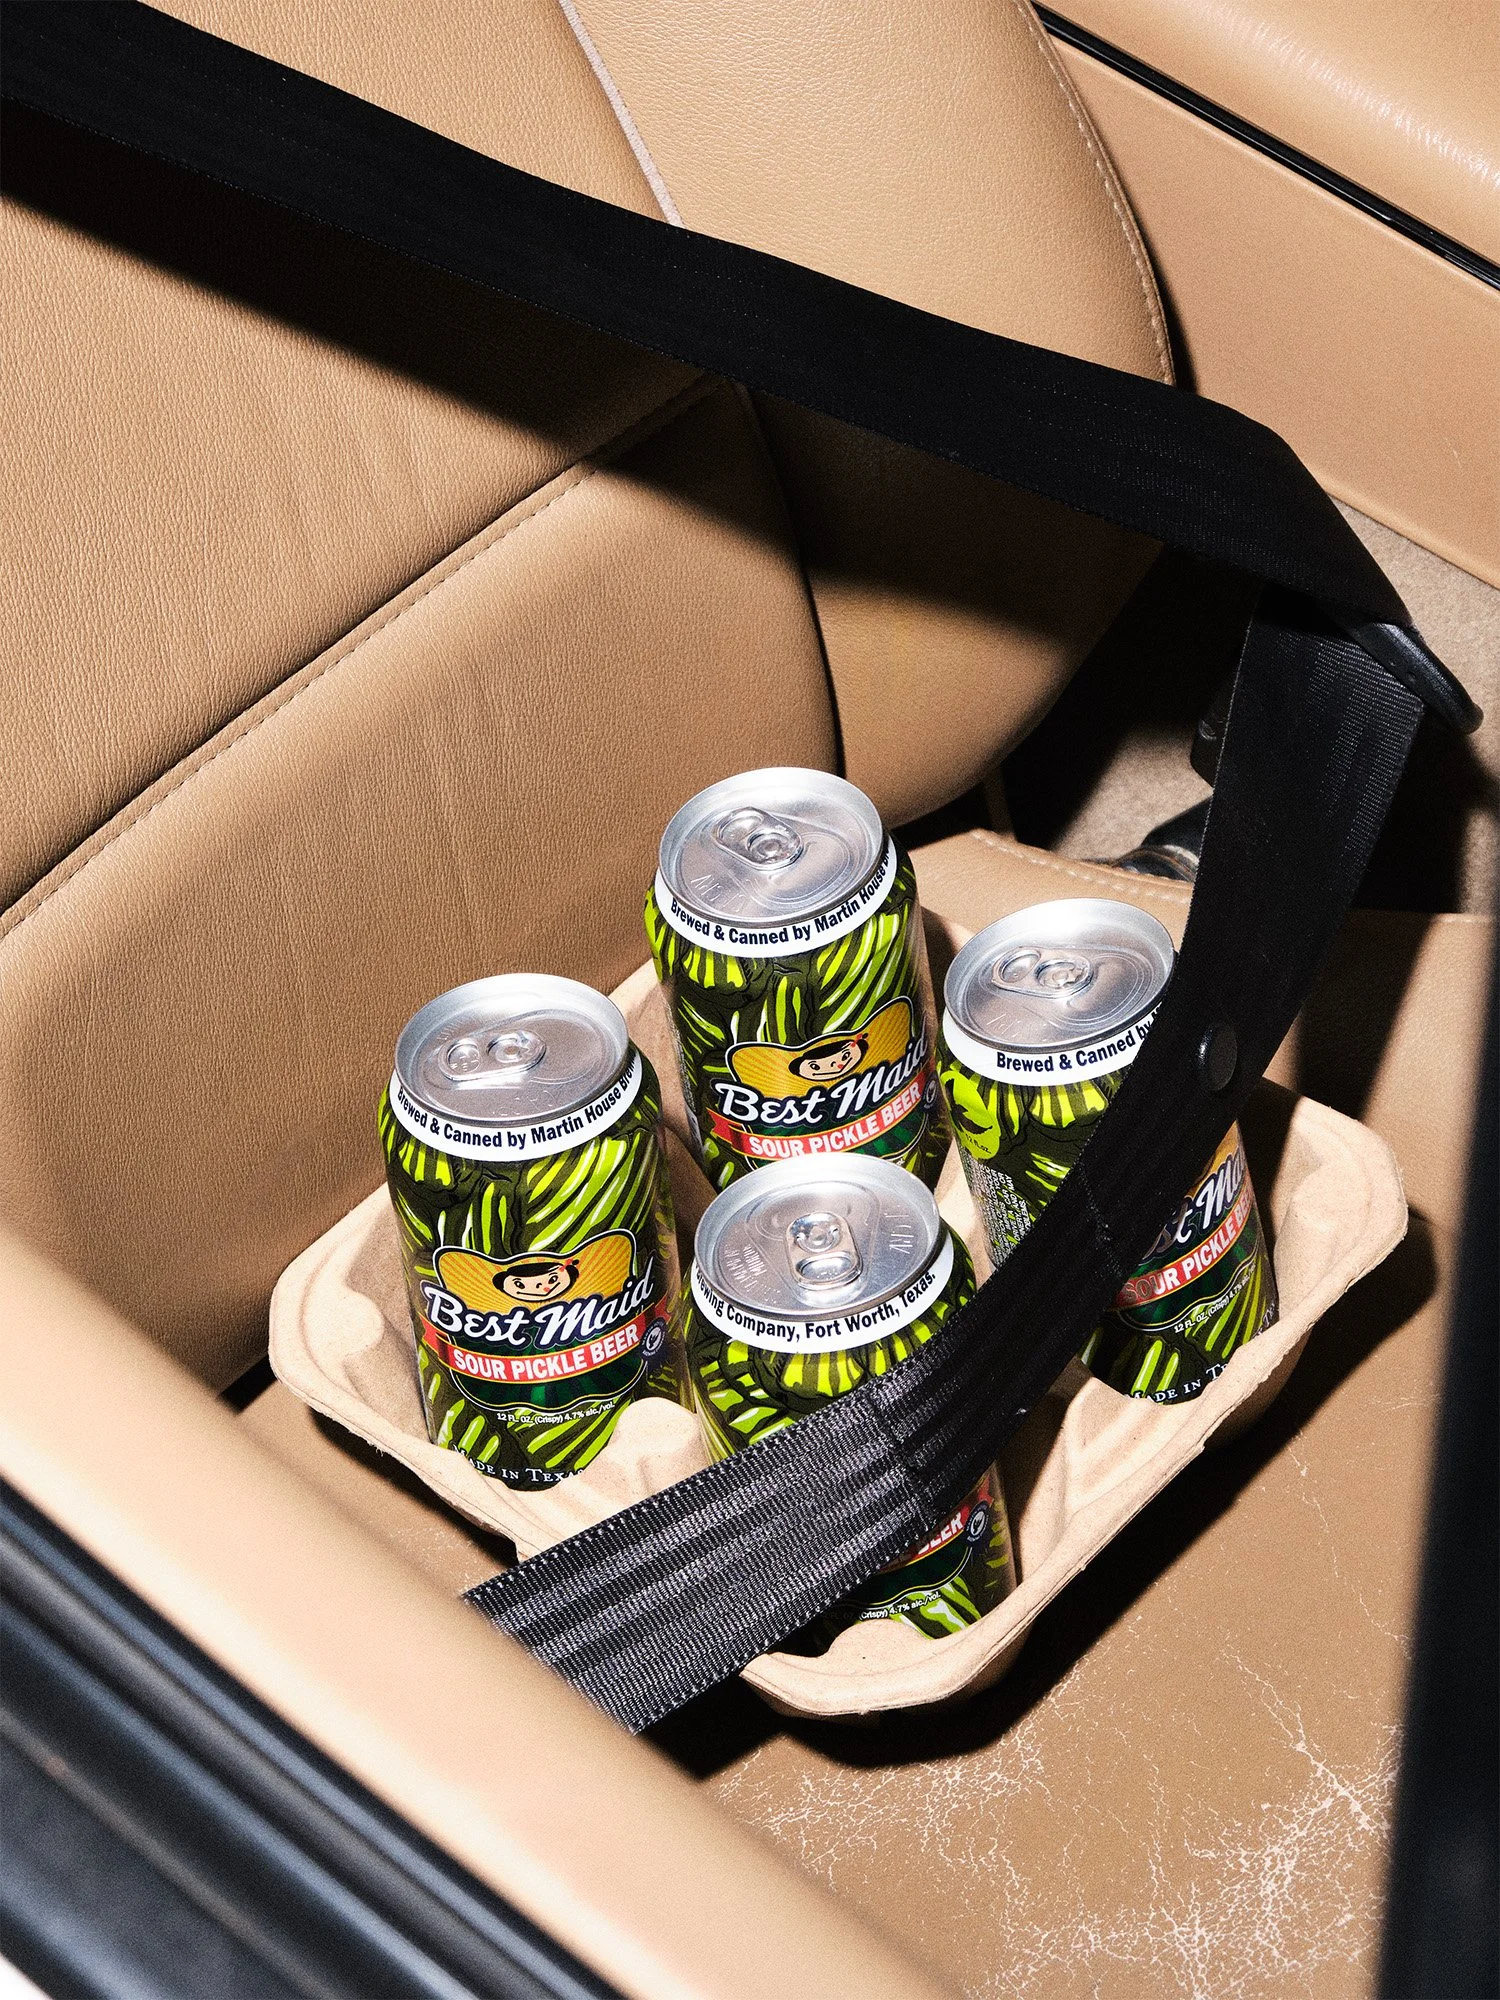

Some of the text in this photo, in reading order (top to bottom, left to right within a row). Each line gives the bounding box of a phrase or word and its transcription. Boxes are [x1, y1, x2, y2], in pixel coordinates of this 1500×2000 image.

[670, 866, 886, 945] Brewed & Canned by Martin House
[715, 1082, 826, 1124] Best
[830, 1018, 928, 1118] Maid
[996, 1051, 1054, 1072] Brewed
[1059, 1054, 1073, 1070] &
[1075, 1030, 1136, 1067] Canned
[398, 1086, 428, 1128] Brewed
[430, 1118, 440, 1135] &
[443, 1125, 502, 1147] Canned
[507, 1132, 527, 1150] by
[530, 1113, 584, 1145] Martin
[584, 1087, 621, 1124] House
[749, 1138, 805, 1158] SOUR
[809, 1120, 880, 1154] PICKLE
[881, 1081, 922, 1127] BEER
[1122, 1268, 1181, 1300] SOUR
[1181, 1217, 1237, 1280] PICKLE
[424, 1286, 531, 1346] Best
[534, 1256, 654, 1346] Maid
[727, 1303, 801, 1343] Company,
[805, 1320, 842, 1339] Fort
[844, 1300, 900, 1334] Worth,
[900, 1271, 936, 1308] Texas.
[1173, 1323, 1184, 1334] 12
[453, 1350, 507, 1380] SOUR
[511, 1352, 588, 1381] PICKLE
[591, 1324, 640, 1365] BEER
[497, 1413, 507, 1421] 12
[534, 1415, 563, 1425] (Crispy)
[564, 1411, 585, 1421] 4.7%
[859, 1609, 889, 1620] (Crispy)
[889, 1603, 911, 1614] 4.7%
